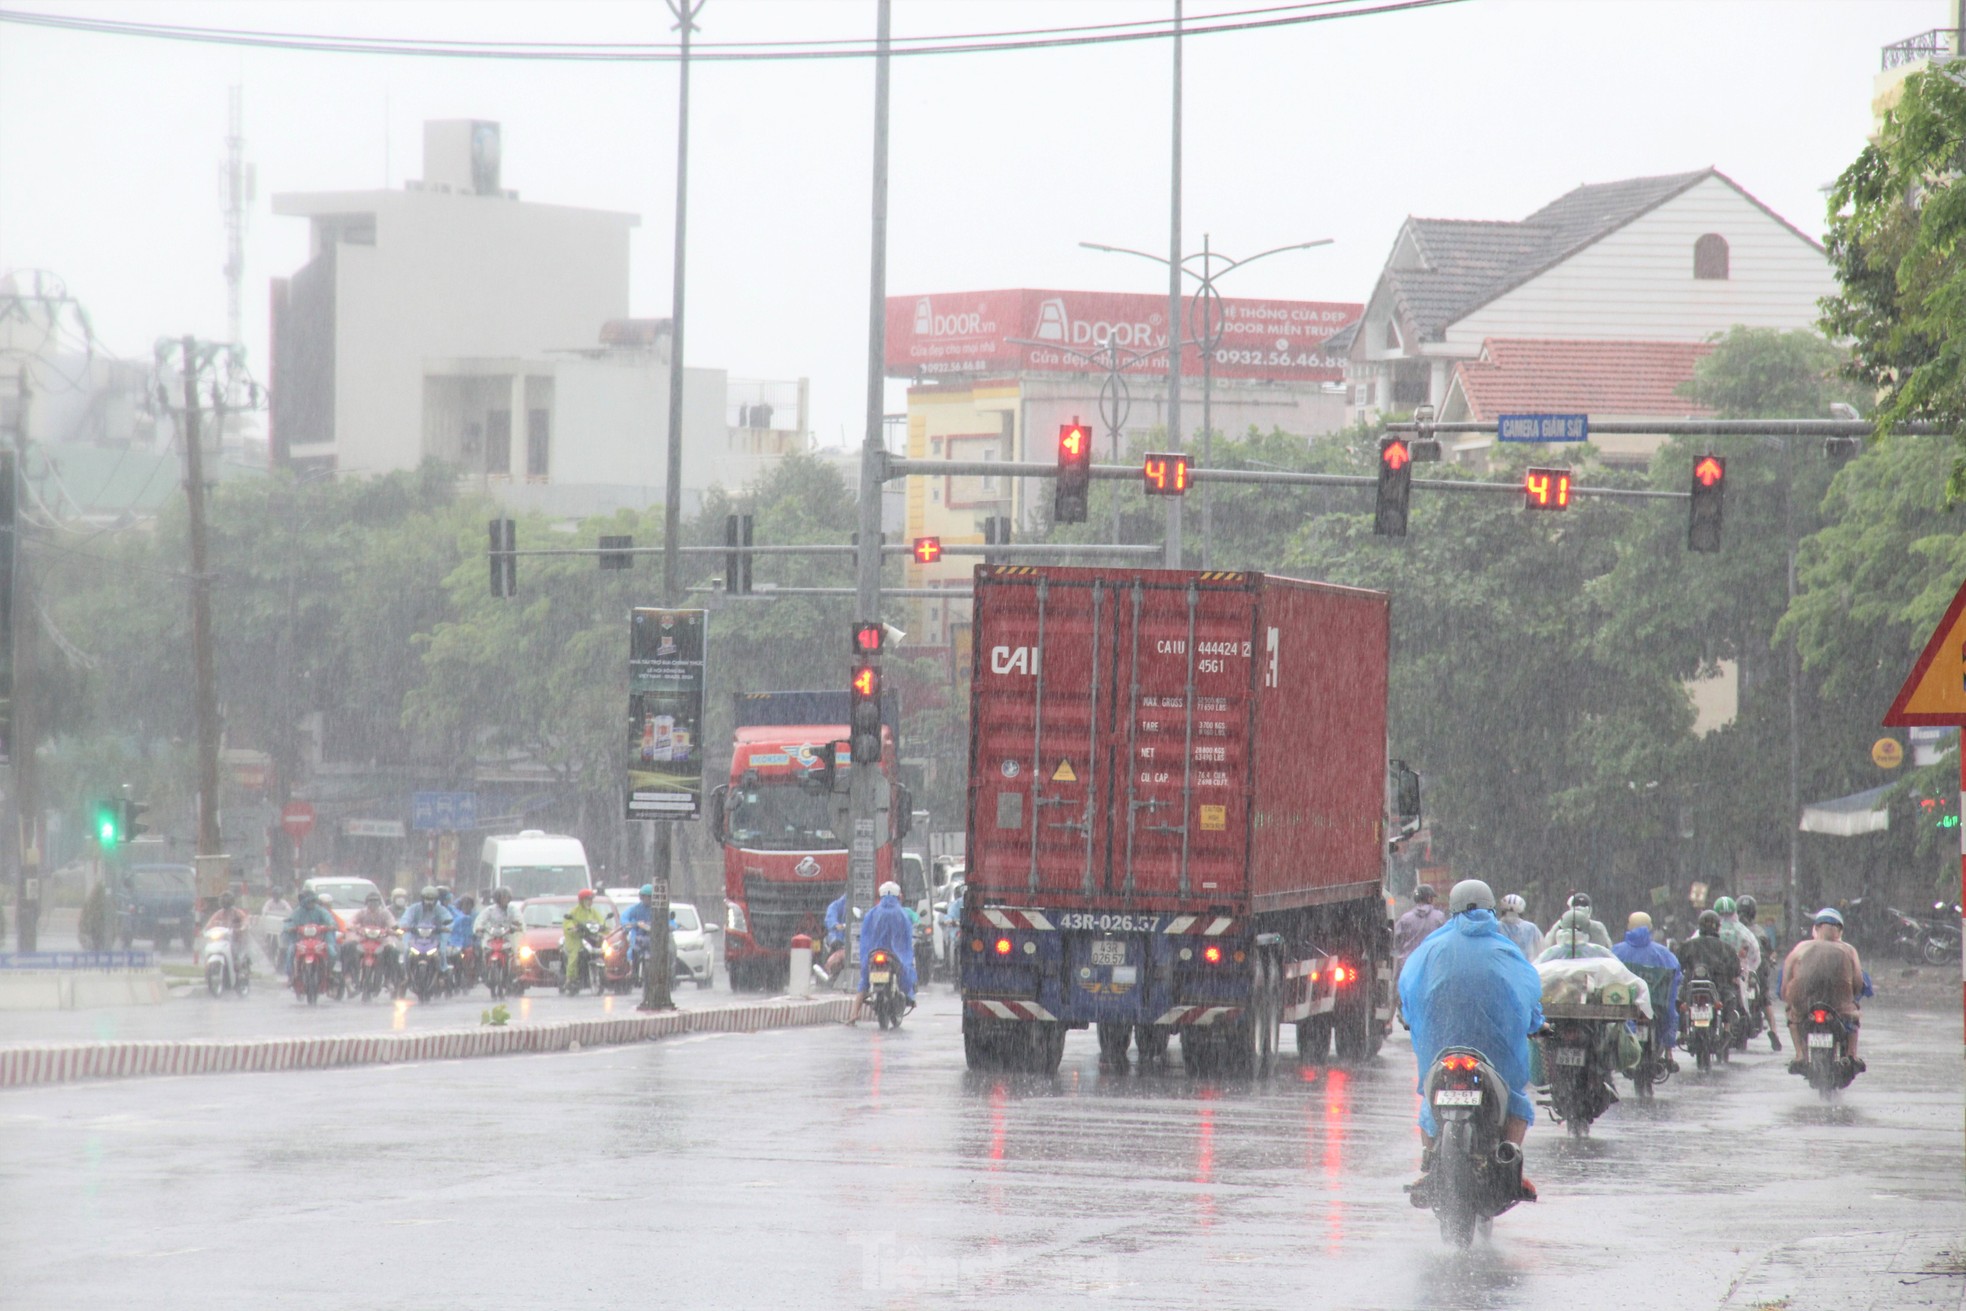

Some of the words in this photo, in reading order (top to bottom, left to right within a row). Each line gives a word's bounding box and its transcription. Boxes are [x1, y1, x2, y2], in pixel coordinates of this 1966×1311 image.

[1240, 303, 1288, 320] THỐNG
[1503, 419, 1539, 437] CAMERA
[1146, 460, 1185, 490] 41
[1528, 475, 1569, 506] 41
[1157, 640, 1185, 654] CAIU
[1198, 641, 1238, 656] 444424
[991, 646, 1038, 675] CAI
[1198, 659, 1224, 673] 45G1
[1060, 913, 1160, 932] 43R-026.57
